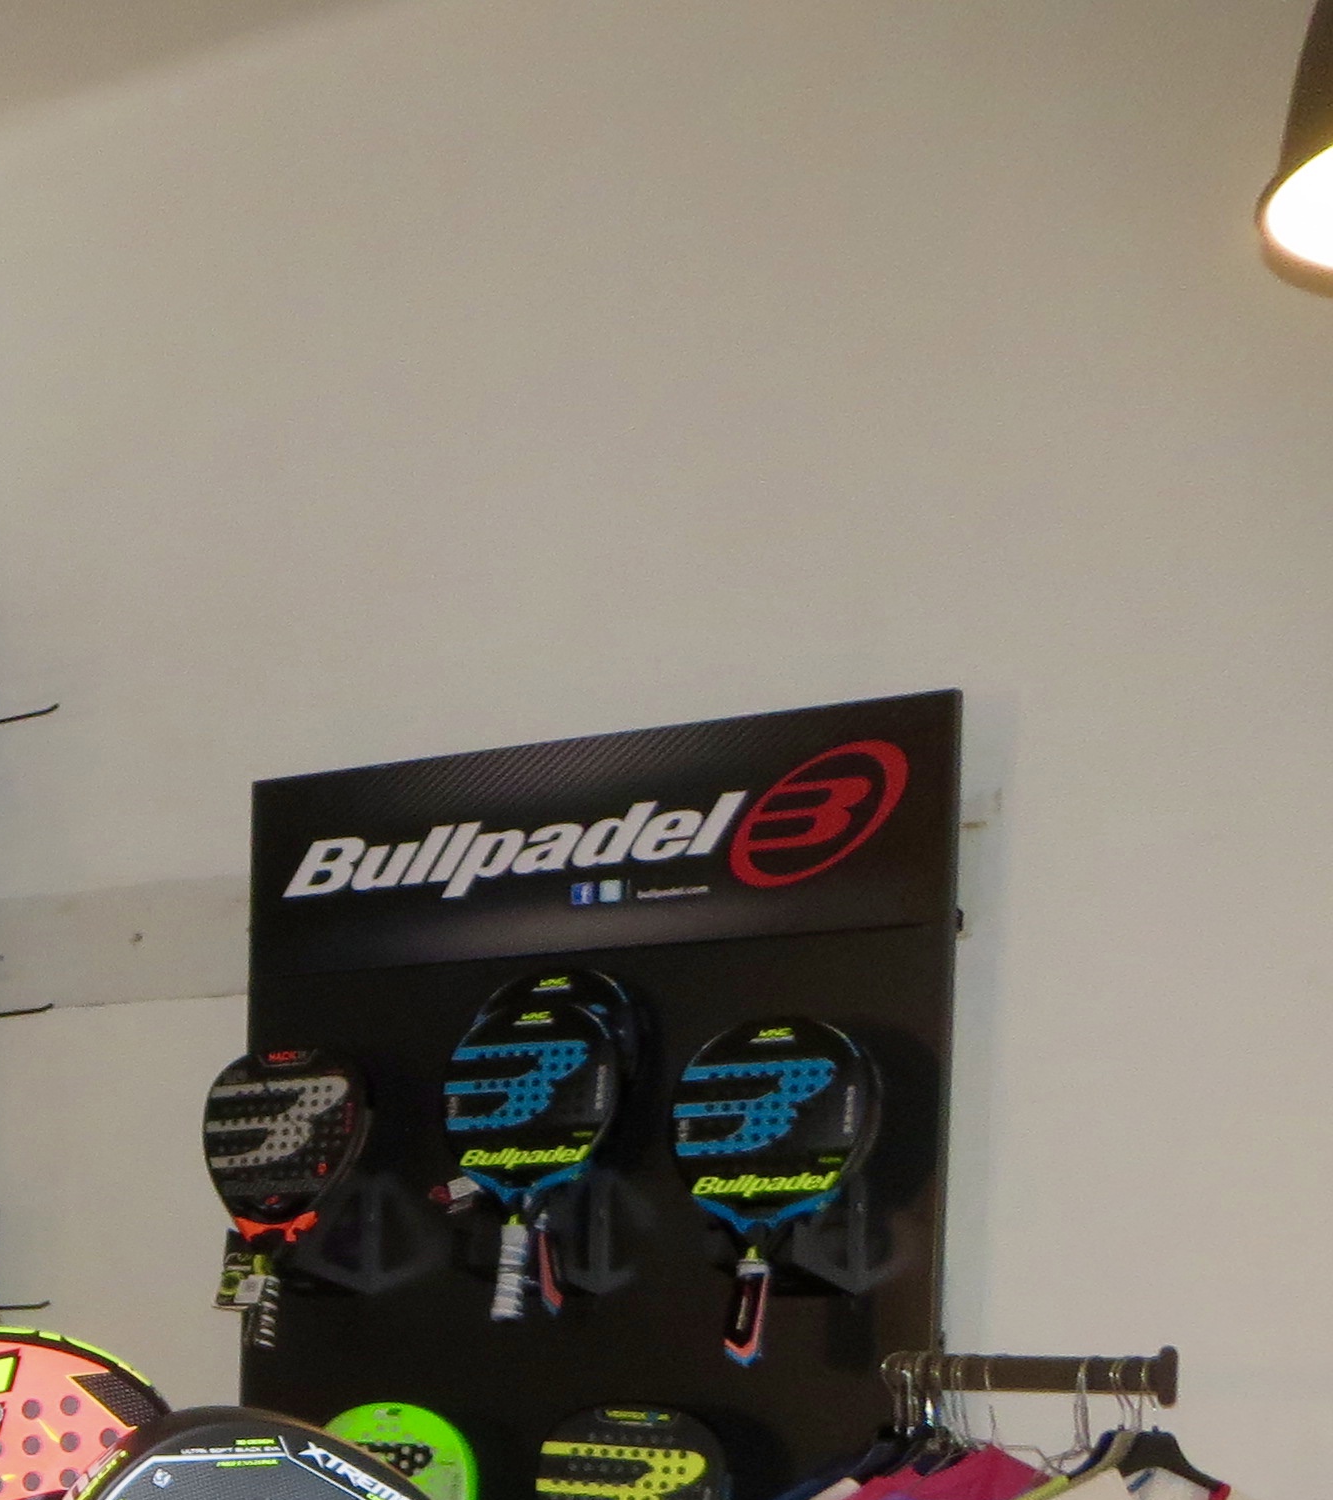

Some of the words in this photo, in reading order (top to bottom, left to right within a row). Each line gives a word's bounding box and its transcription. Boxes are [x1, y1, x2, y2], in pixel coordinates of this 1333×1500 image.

[282, 790, 747, 902] Bullpadel
[459, 1144, 593, 1171] Bullpadel
[691, 1170, 842, 1199] Bullpadel
